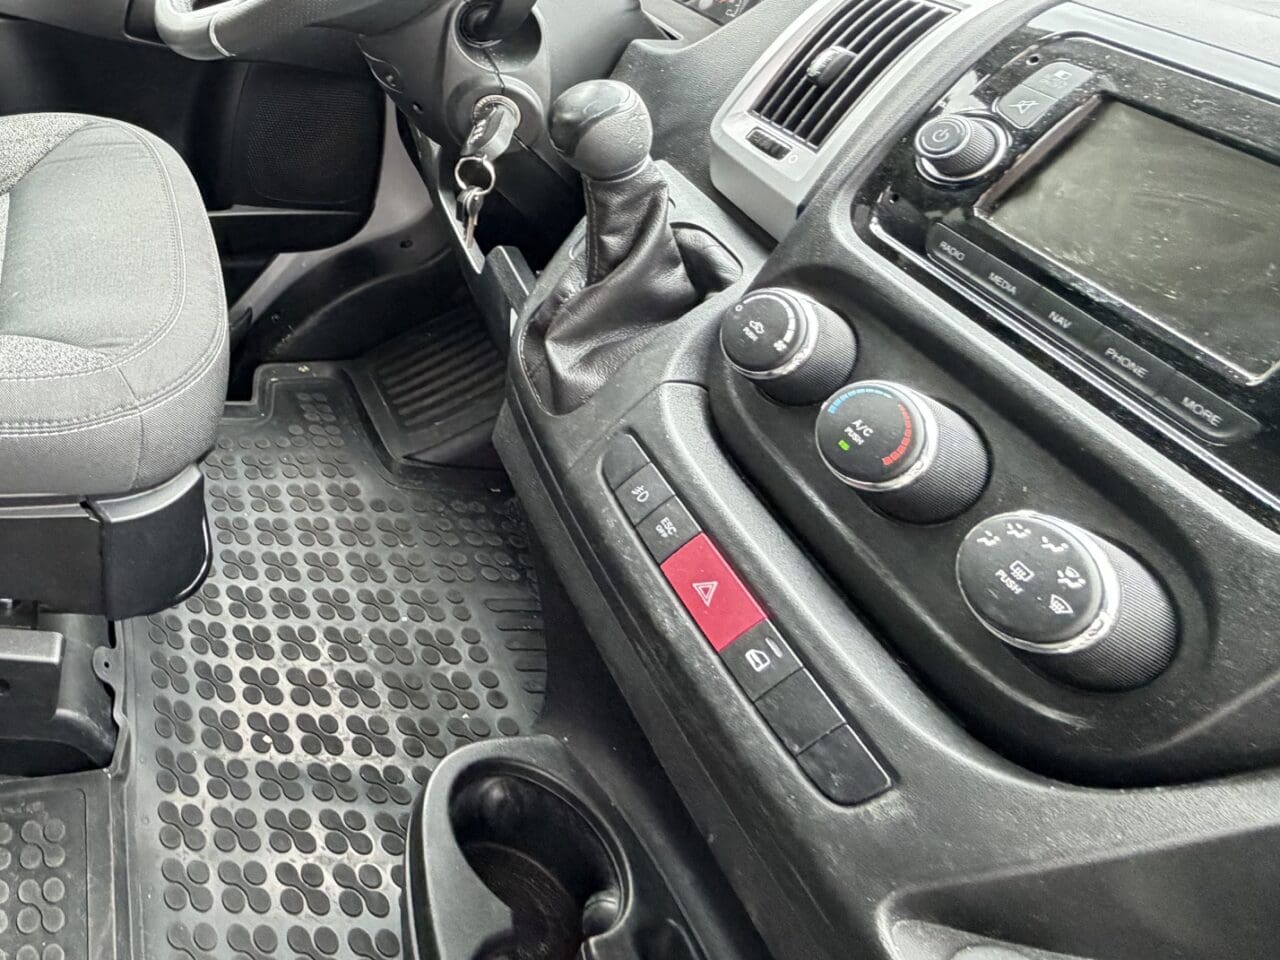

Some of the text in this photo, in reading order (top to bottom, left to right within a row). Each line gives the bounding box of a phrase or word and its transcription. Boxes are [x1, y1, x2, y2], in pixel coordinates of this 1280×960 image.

[940, 241, 966, 261] RADIO
[988, 272, 1017, 295] MEDIA
[1048, 311, 1072, 329] NAV
[1104, 347, 1149, 378] PHONE
[1181, 396, 1223, 428] MORE
[843, 426, 865, 445] PUSH
[851, 419, 874, 437] A/C
[660, 516, 677, 535] ESC
[995, 569, 1024, 595] PUSH
